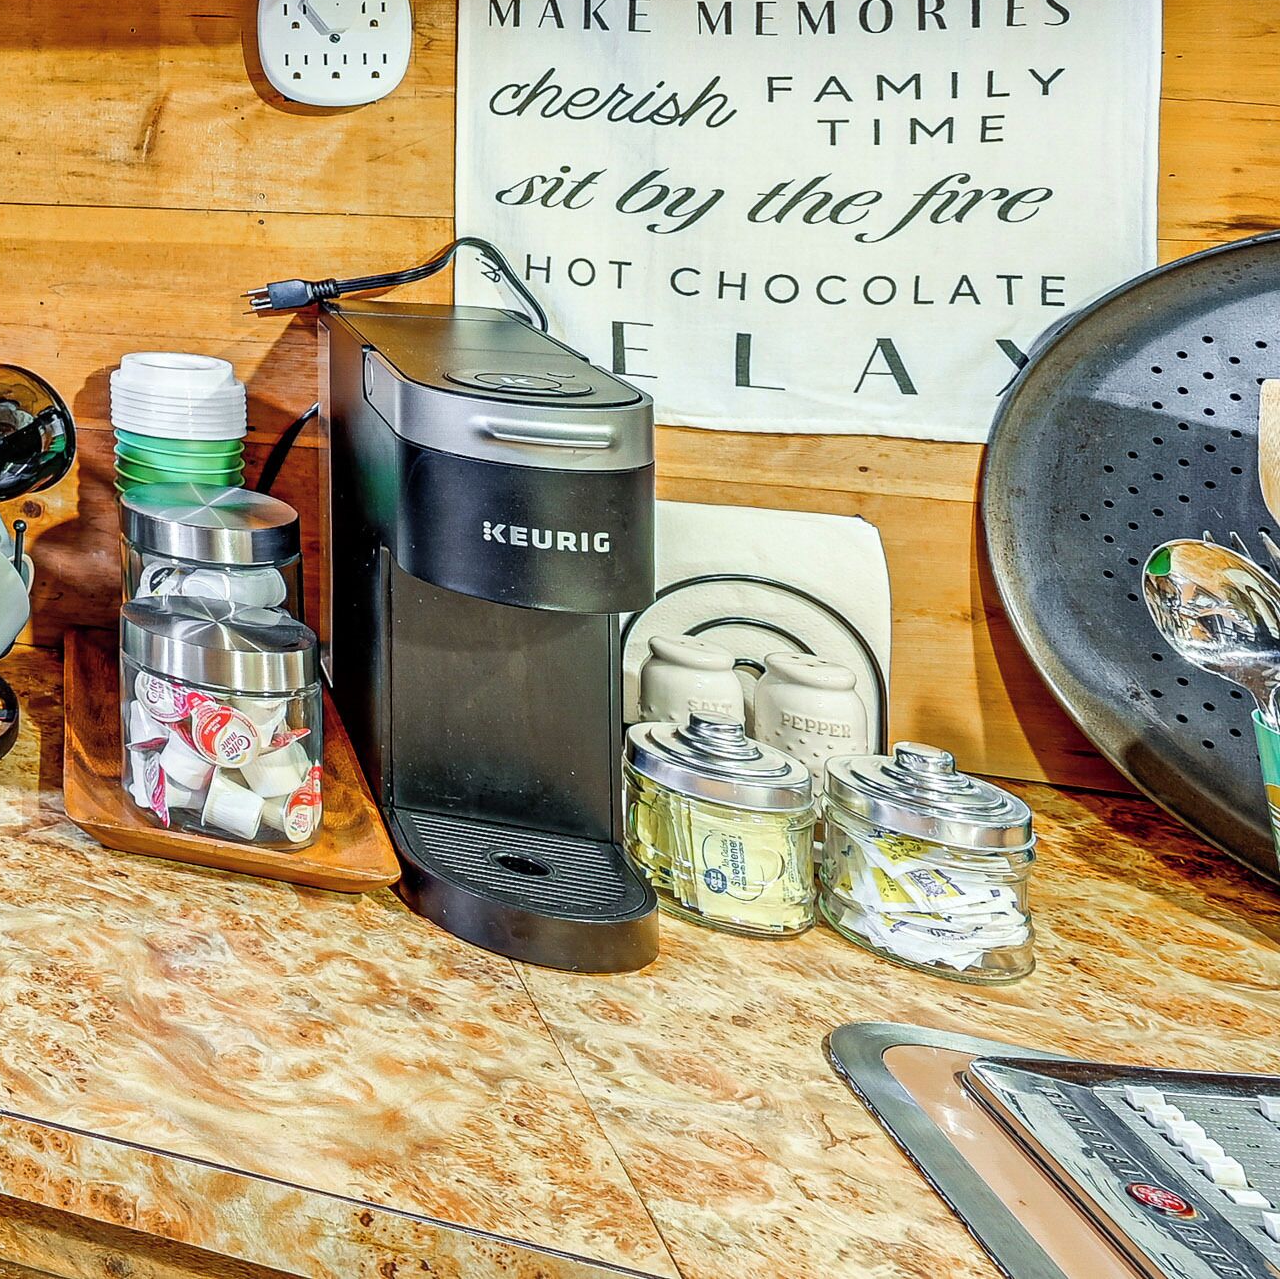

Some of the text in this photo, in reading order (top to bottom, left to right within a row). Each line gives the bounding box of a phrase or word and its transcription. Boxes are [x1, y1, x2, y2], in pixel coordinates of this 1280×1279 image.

[488, 67, 1067, 128] cherish FAMILY
[817, 113, 1006, 146] TIME
[495, 165, 1055, 244] sit by the fire
[524, 253, 1067, 307] HOT CHOCOLATE
[483, 521, 610, 553] KEURIG
[781, 713, 852, 739] PEPPER
